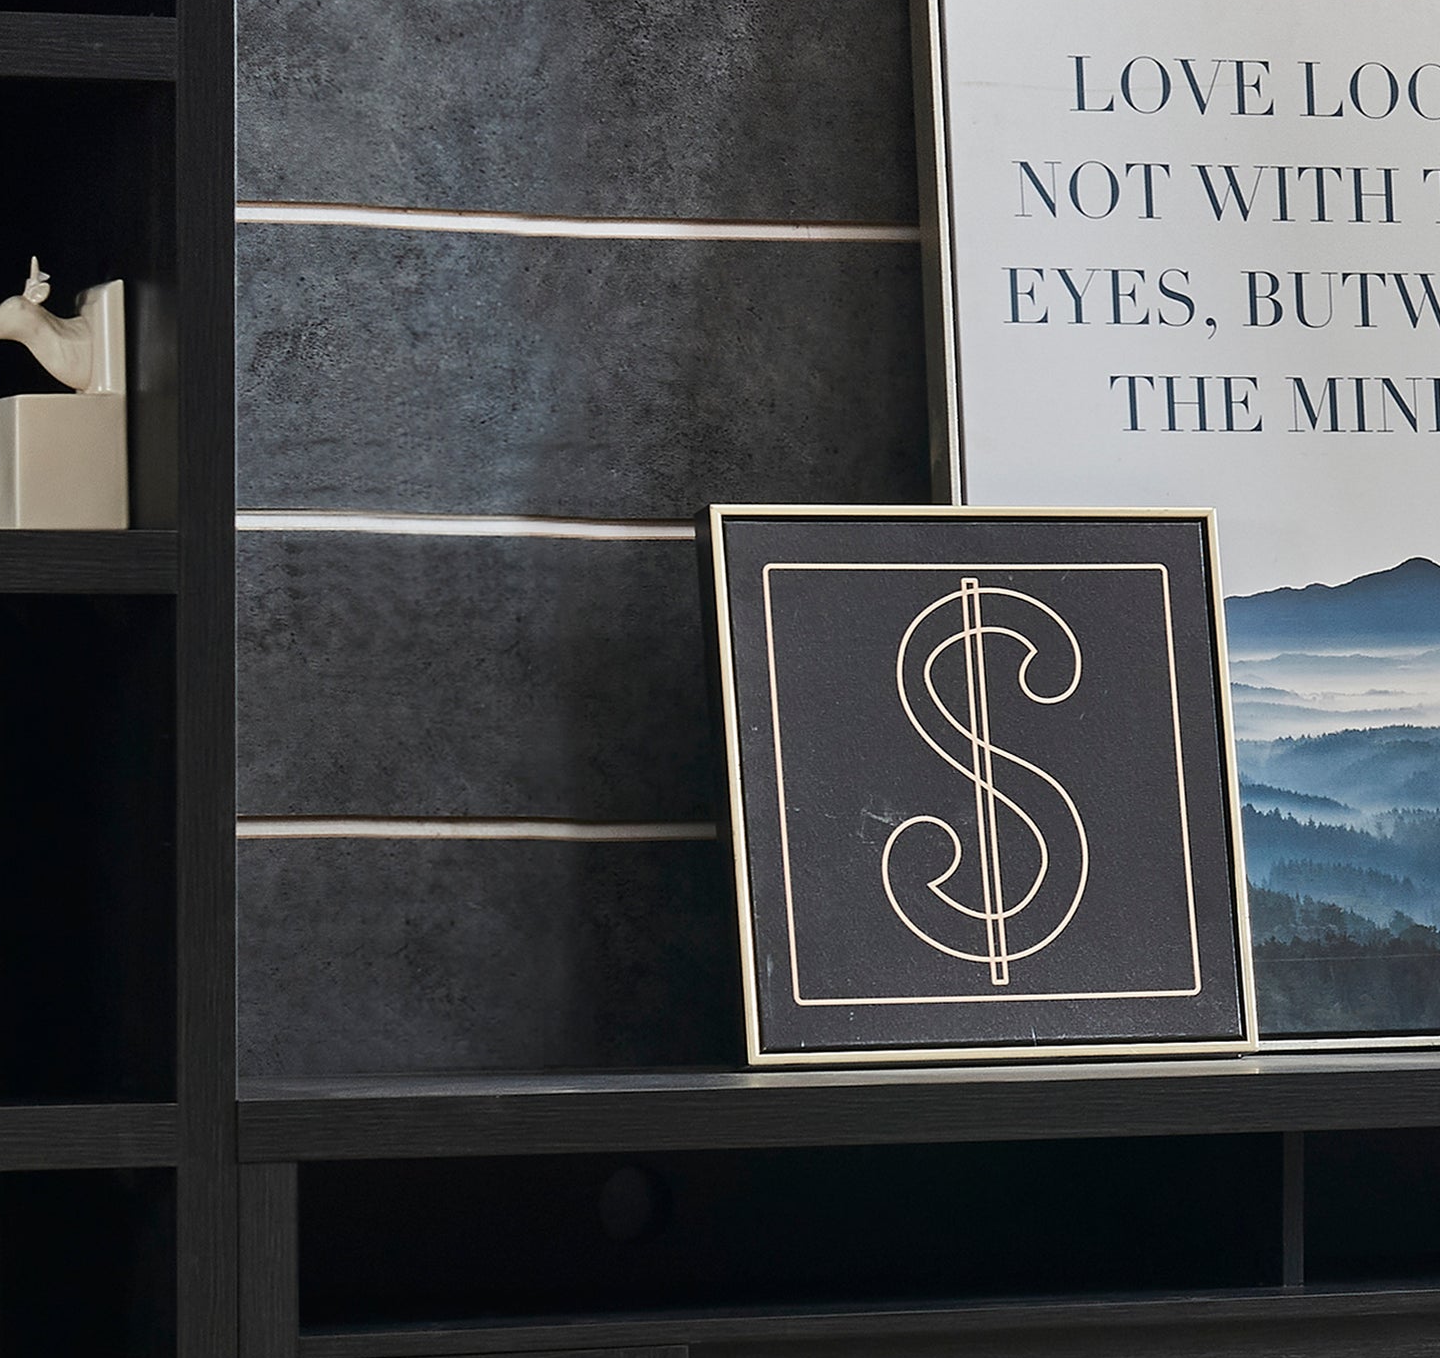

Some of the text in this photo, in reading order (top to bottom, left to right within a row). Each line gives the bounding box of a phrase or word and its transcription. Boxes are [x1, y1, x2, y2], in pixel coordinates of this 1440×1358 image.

[1067, 54, 1275, 116] LOVE
[1011, 159, 1172, 220] NOT
[1190, 163, 1402, 224] WITH
[1000, 266, 1218, 340] EYES,
[1109, 374, 1263, 433] THE
